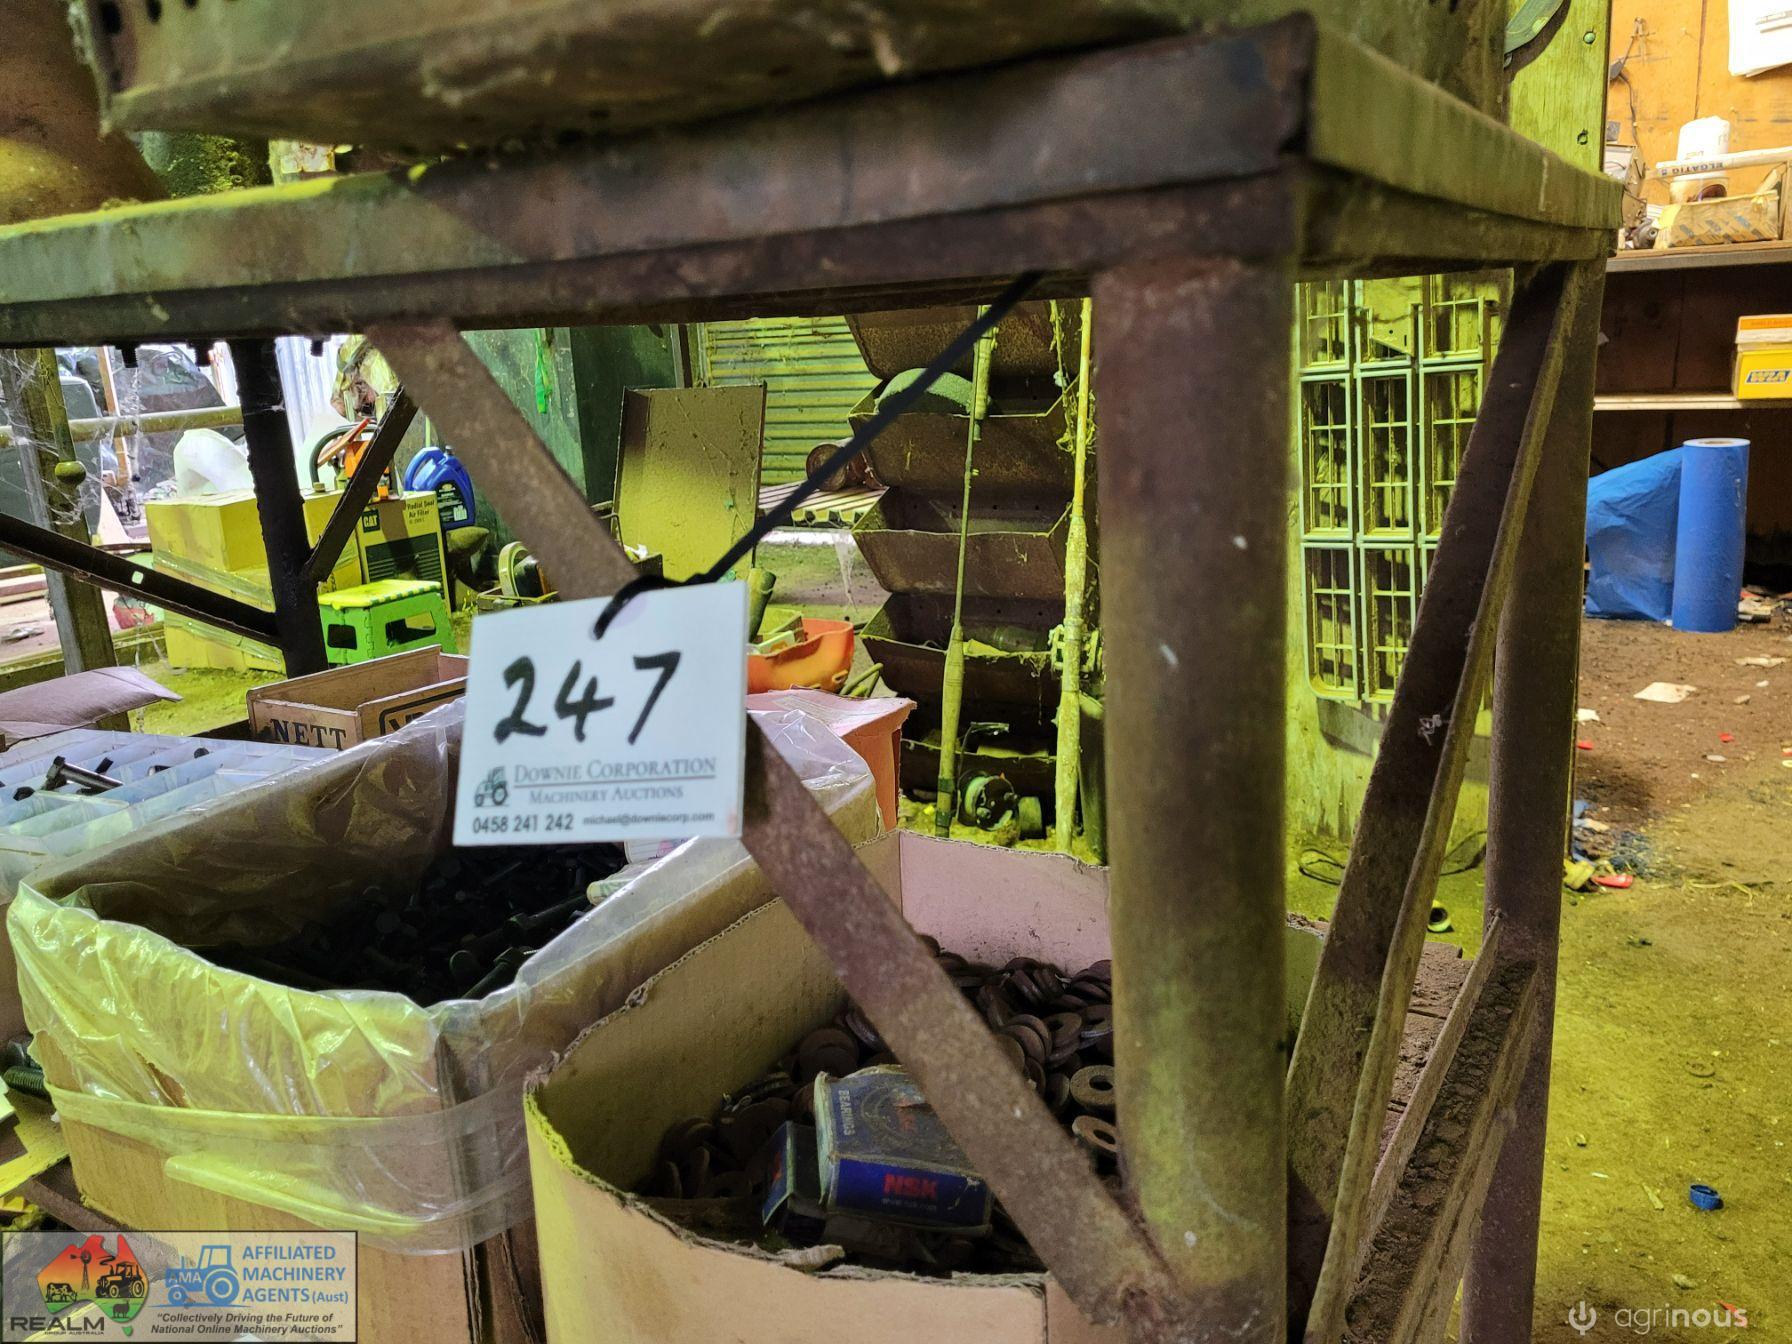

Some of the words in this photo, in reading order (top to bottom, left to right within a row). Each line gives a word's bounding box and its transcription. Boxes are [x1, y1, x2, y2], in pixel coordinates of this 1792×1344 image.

[363, 515, 378, 527] CAT
[493, 651, 682, 746] 247
[270, 718, 347, 751] NETT
[586, 757, 717, 779] CORPORATION
[529, 788, 608, 805] MACHINERY
[611, 785, 684, 801] AUCTIONS
[473, 815, 509, 834] 0458
[513, 814, 539, 832] 241
[545, 813, 574, 831] 242
[583, 811, 716, 827] michael@downiecorp.com
[883, 1173, 938, 1200] NSK
